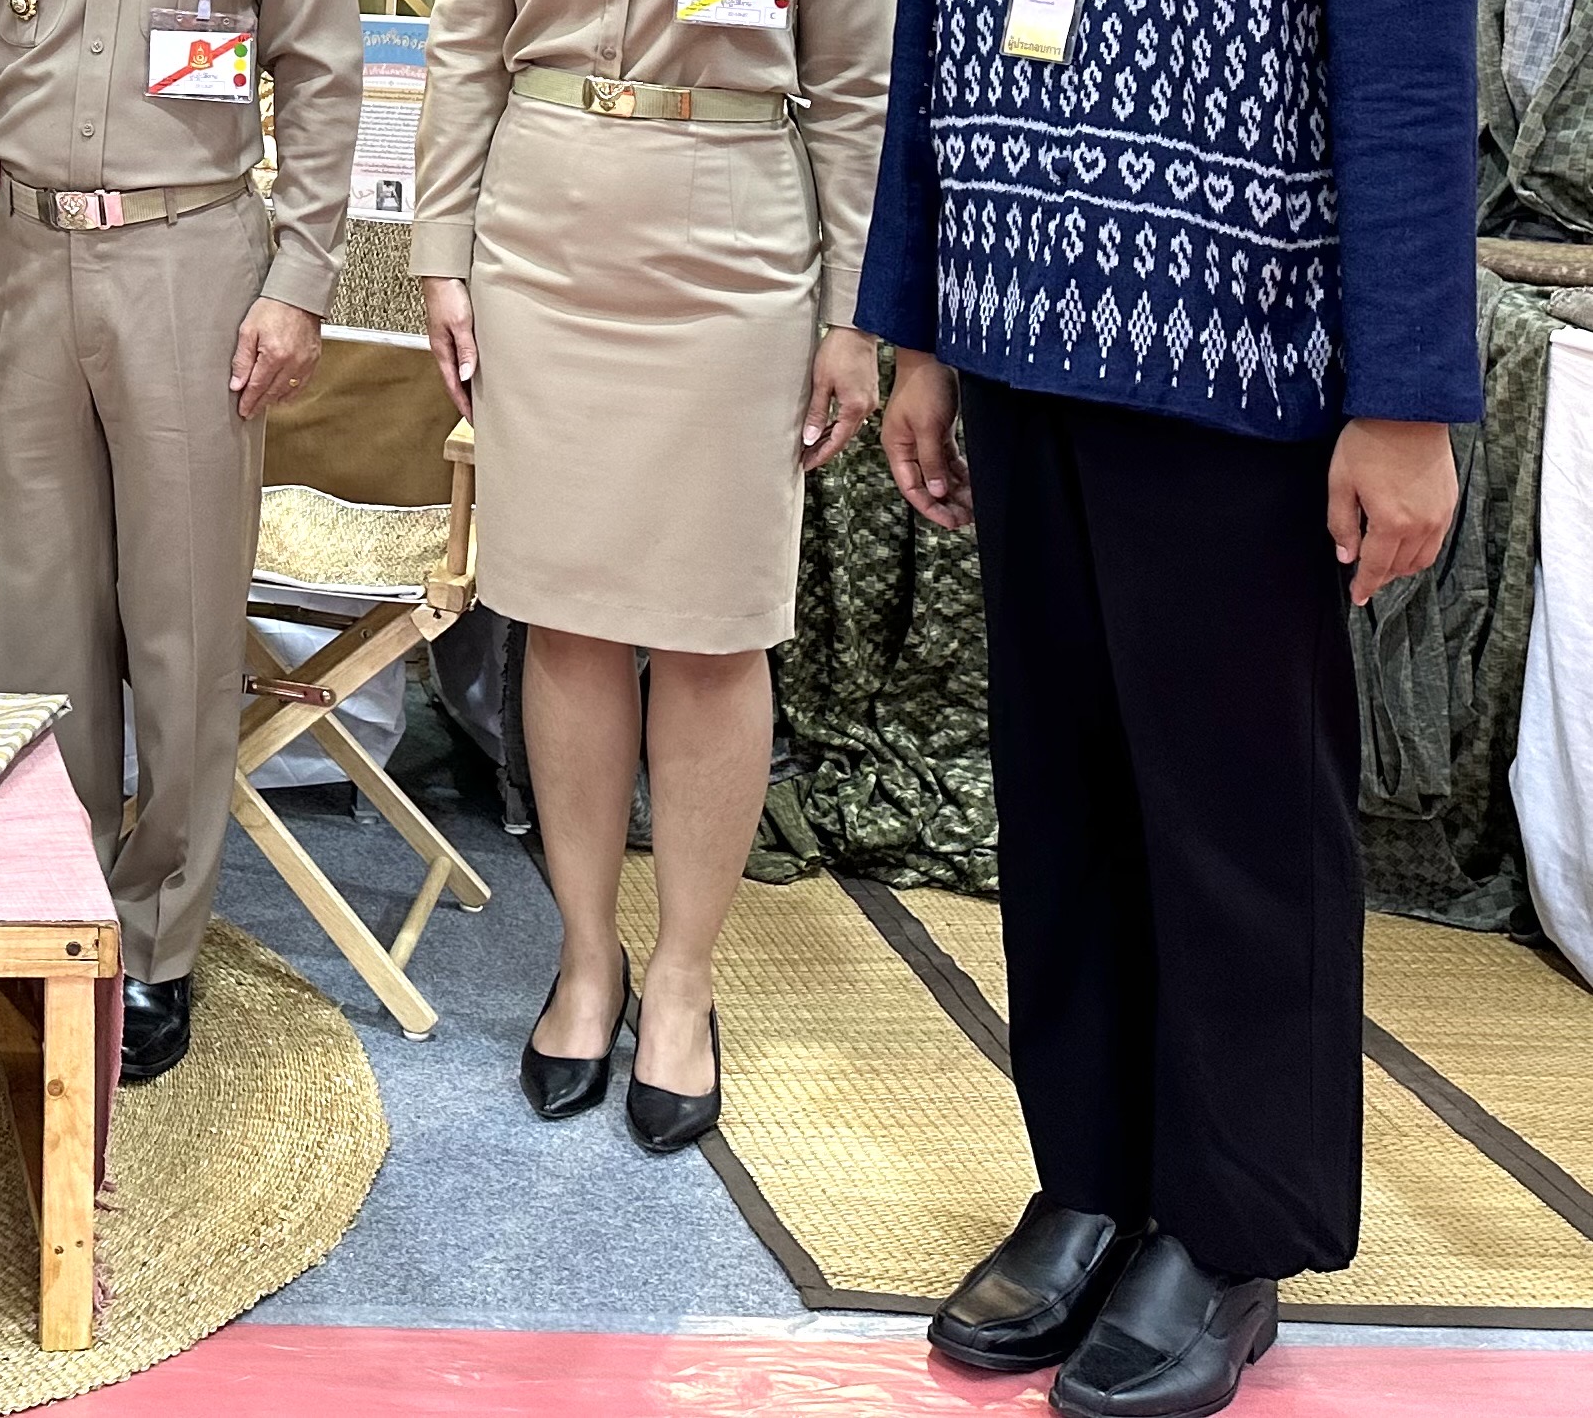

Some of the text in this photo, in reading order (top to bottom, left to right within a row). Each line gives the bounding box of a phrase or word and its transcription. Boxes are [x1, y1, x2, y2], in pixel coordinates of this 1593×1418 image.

[1008, 35, 1061, 55] ผู้ประกอบการ
